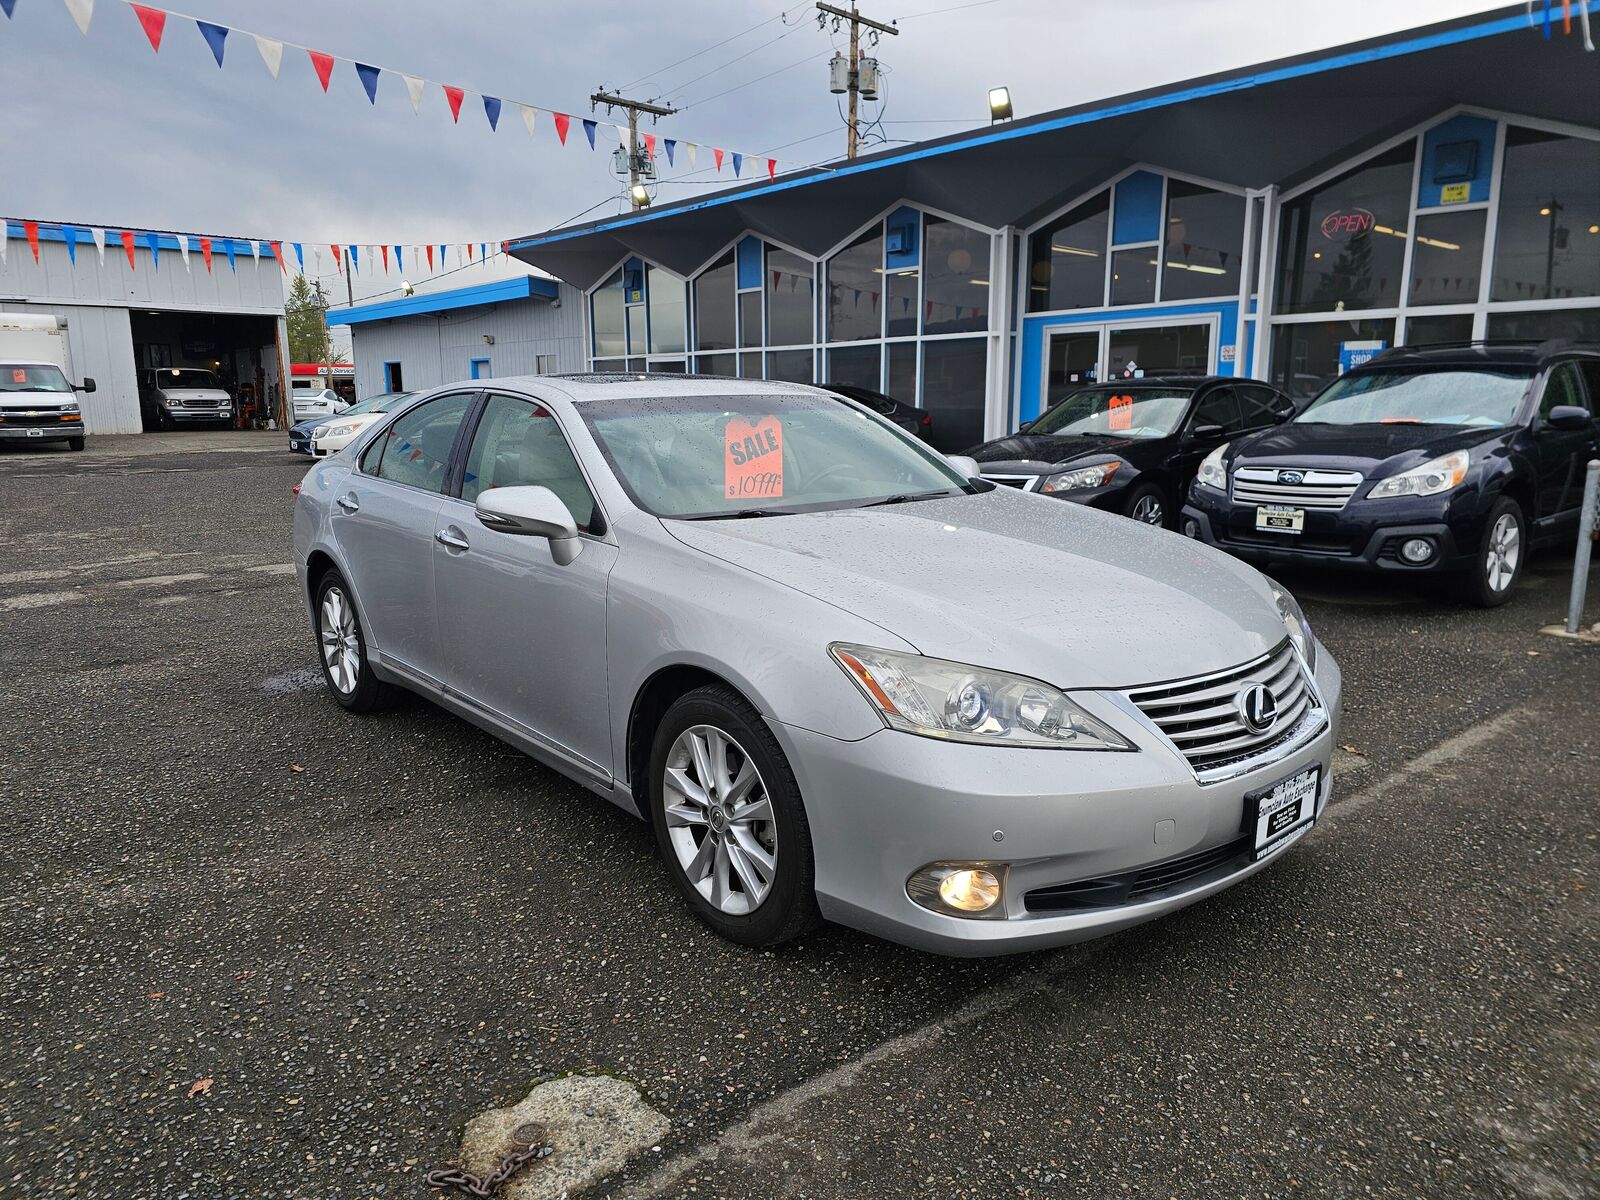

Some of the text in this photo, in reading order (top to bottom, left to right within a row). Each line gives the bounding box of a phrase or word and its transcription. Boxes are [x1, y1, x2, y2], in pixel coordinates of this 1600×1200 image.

[1323, 213, 1371, 233] OPEN
[1350, 354, 1372, 365] SHOP
[1111, 401, 1130, 416] SALE
[729, 428, 779, 465] SALE
[1283, 793, 1294, 804] Auto
[1294, 780, 1316, 799] Exchange
